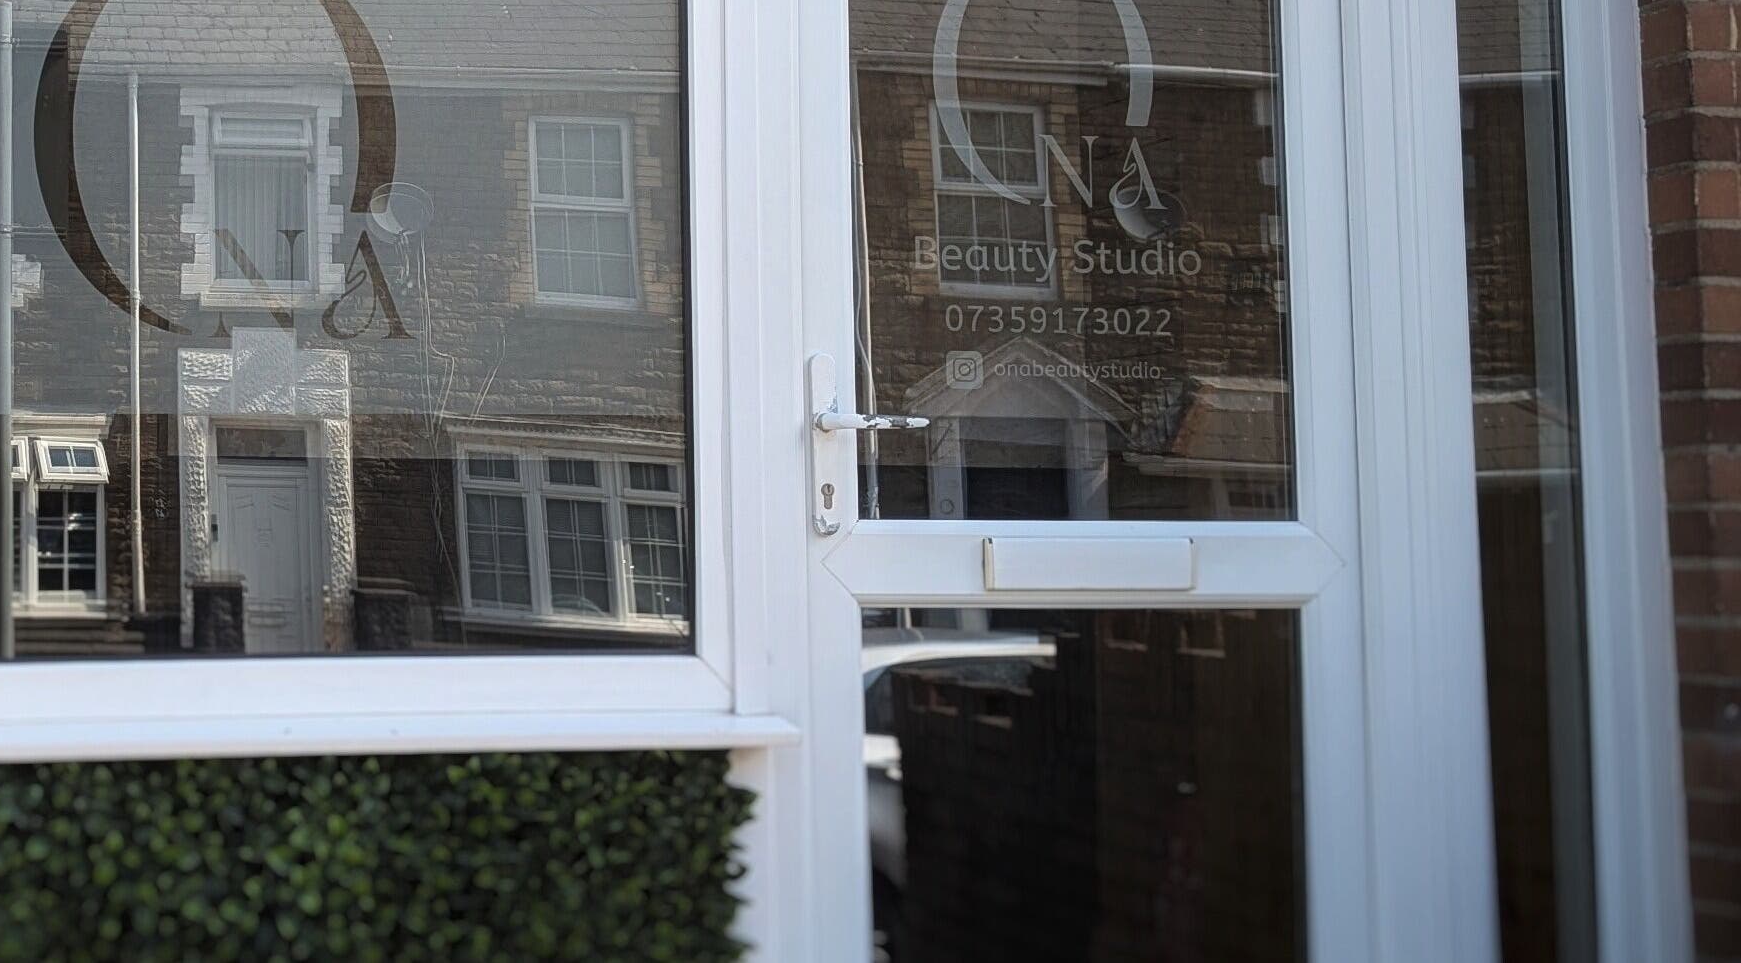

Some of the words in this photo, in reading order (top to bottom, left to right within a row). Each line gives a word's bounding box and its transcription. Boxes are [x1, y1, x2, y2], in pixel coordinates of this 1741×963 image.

[914, 235, 1058, 282] Beauty
[1073, 239, 1202, 276] Studio
[945, 304, 1172, 336] 07359173022
